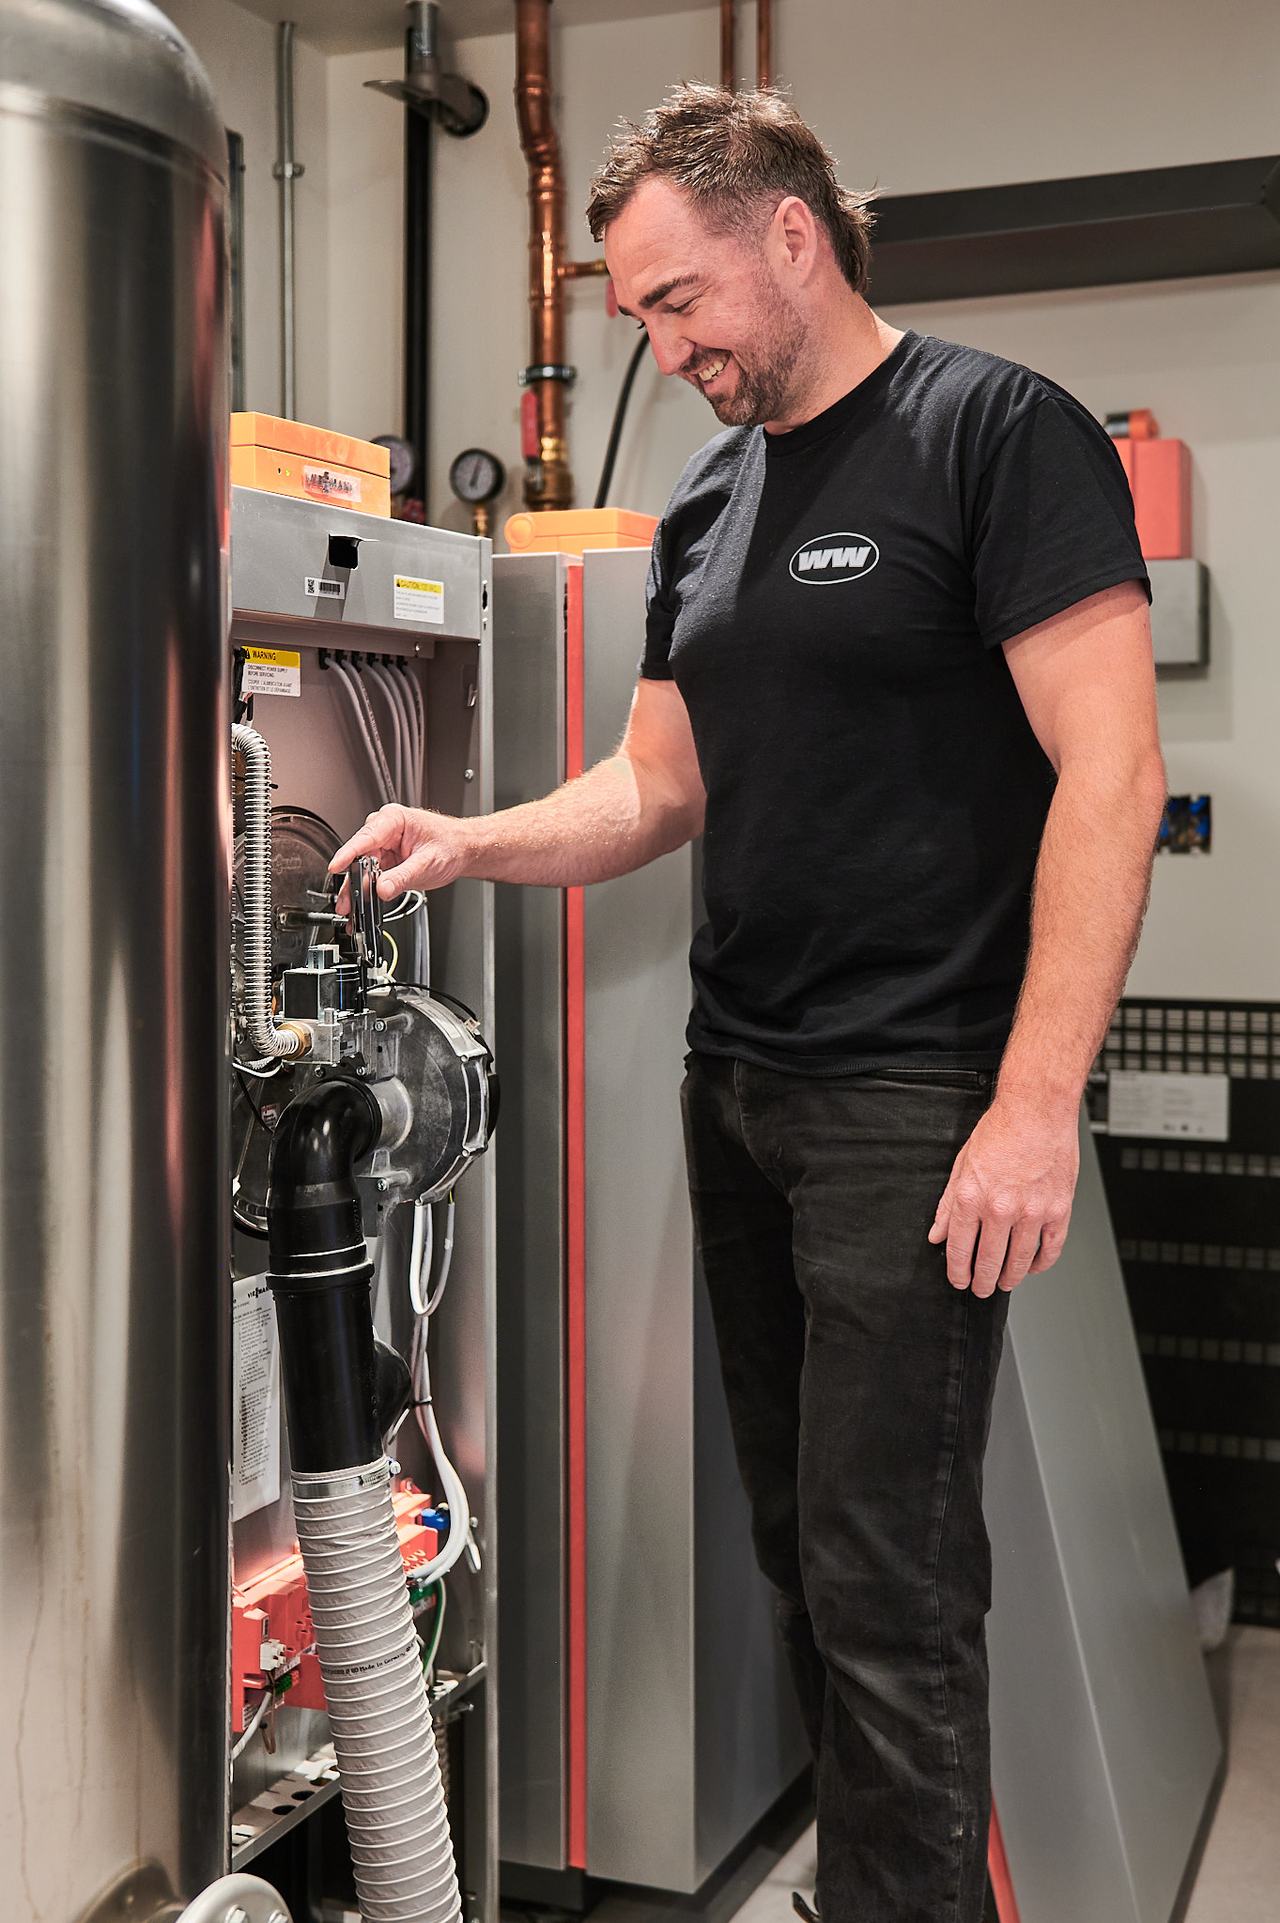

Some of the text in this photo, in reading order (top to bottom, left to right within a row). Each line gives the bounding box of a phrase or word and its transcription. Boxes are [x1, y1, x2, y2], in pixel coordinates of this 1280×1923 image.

[798, 546, 872, 572] WW
[252, 650, 277, 660] WARNING
[360, 1664, 375, 1672] Made
